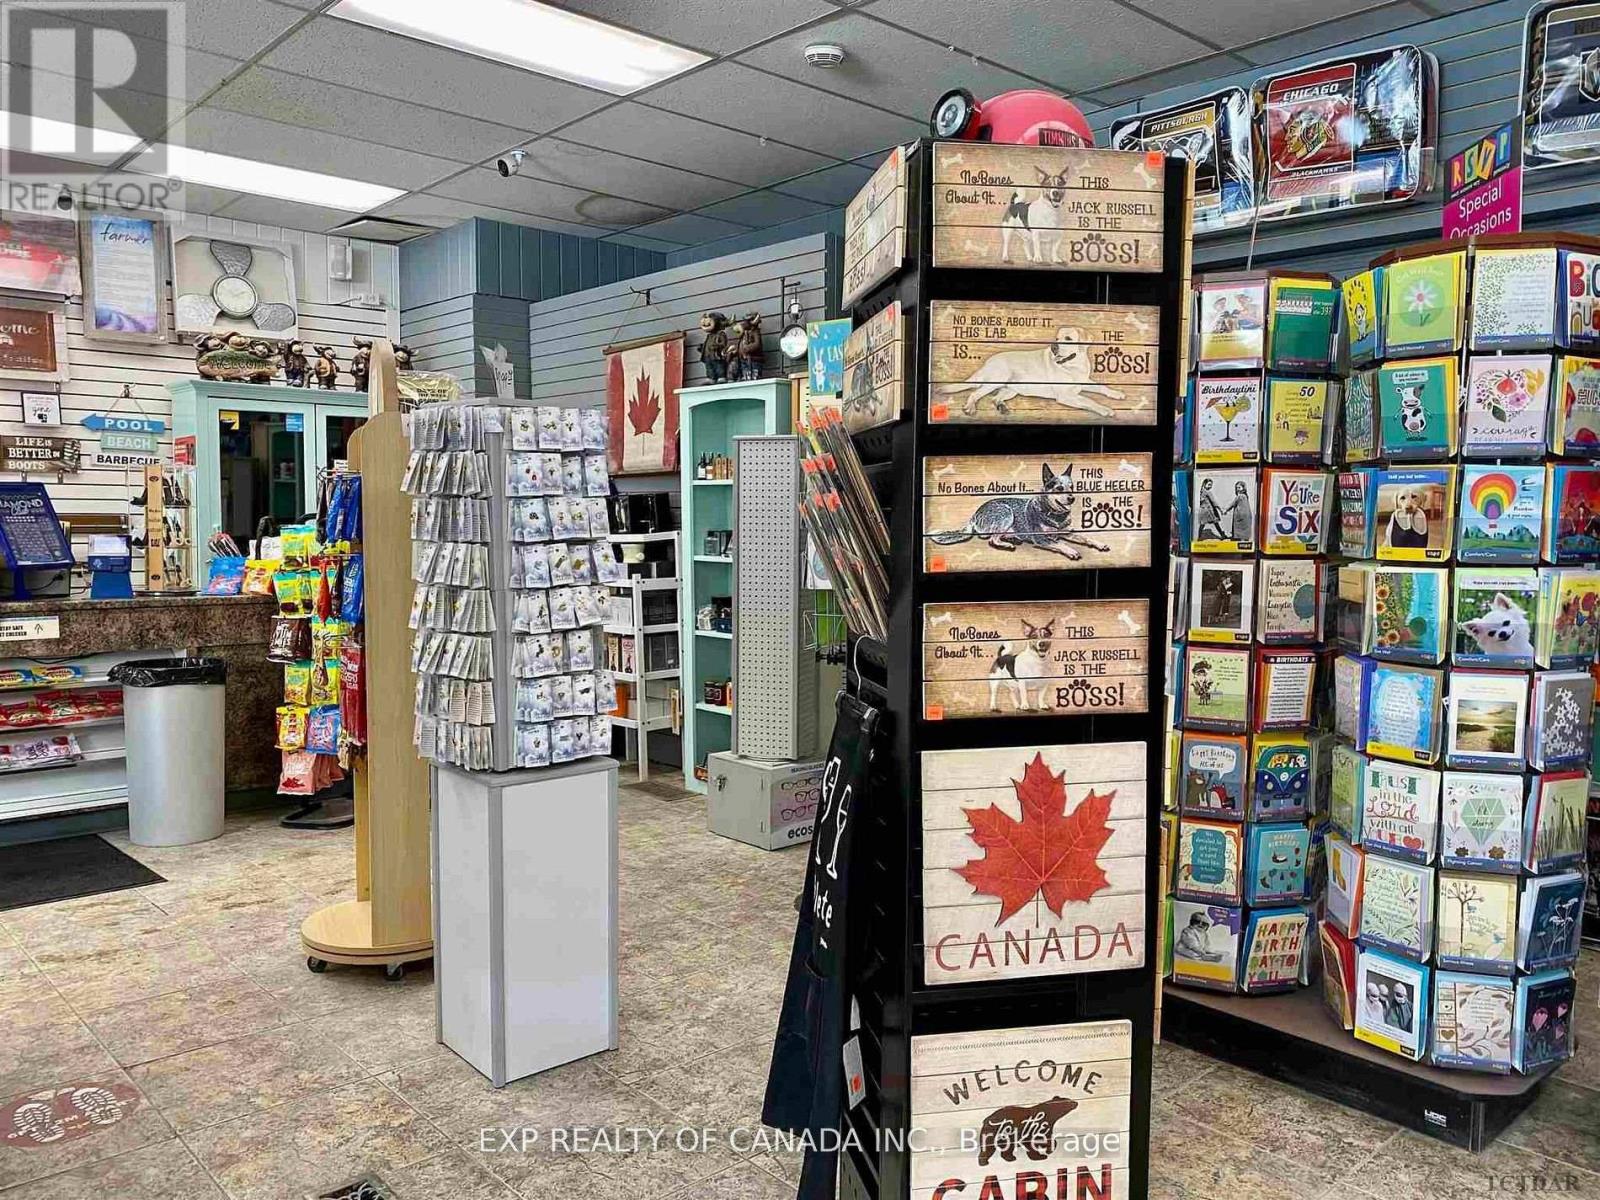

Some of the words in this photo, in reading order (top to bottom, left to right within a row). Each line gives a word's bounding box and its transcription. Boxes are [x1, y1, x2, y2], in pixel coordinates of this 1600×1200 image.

[1283, 83, 1339, 102] CHICAGO
[1150, 112, 1208, 133] PITTSBURGH
[1080, 176, 1110, 189] THIS
[945, 190, 979, 204] About
[1459, 177, 1502, 221] Special
[1068, 201, 1101, 215] JACK
[1105, 203, 1157, 216] RUSSELL
[1078, 217, 1090, 229] IS
[1096, 217, 1122, 229] THE
[1450, 207, 1512, 240] Occasions
[100, 221, 151, 246] farmer
[1070, 236, 1140, 264] BOSS!
[953, 315, 967, 325] NO
[971, 315, 1001, 326] BONES
[1006, 316, 1039, 327] ABOUT
[953, 326, 981, 338] THIS
[984, 327, 1007, 338] LAB
[1101, 331, 1124, 342] THE
[1093, 350, 1150, 374] BOSS!
[1201, 385, 1257, 395] Birthdaytini
[1300, 386, 1316, 397] 50
[104, 418, 153, 431] POOL
[15, 437, 43, 446] LIFE
[107, 436, 151, 449] BEACH
[8, 448, 52, 458] BETTER
[96, 454, 160, 465] BARBECUE
[8, 461, 46, 470] BOOTS
[1080, 468, 1103, 480] THIS
[937, 482, 952, 494] No
[955, 482, 984, 493] Bones
[987, 482, 1015, 493] About
[1076, 480, 1101, 491] BLUE
[1104, 480, 1145, 491] HEELER
[1081, 497, 1092, 507] IS
[1112, 496, 1134, 507] THE
[1081, 505, 1142, 529] BOSS!
[1065, 627, 1094, 638] THIS
[935, 646, 966, 659] About
[1054, 650, 1086, 661] JACK
[1091, 649, 1141, 661] RUSSELL
[1064, 664, 1075, 675] IS
[1081, 663, 1106, 675] THE
[1056, 682, 1125, 708] BOSS!
[1366, 796, 1419, 824] Lord
[787, 825, 814, 839] ecos
[1257, 922, 1304, 937] HAPPY
[934, 922, 1135, 971] CANADA
[943, 1059, 1103, 1106] WELCOME
[988, 1113, 1014, 1139] to
[1019, 1111, 1052, 1139] the
[931, 1163, 1114, 1200] CABIN
